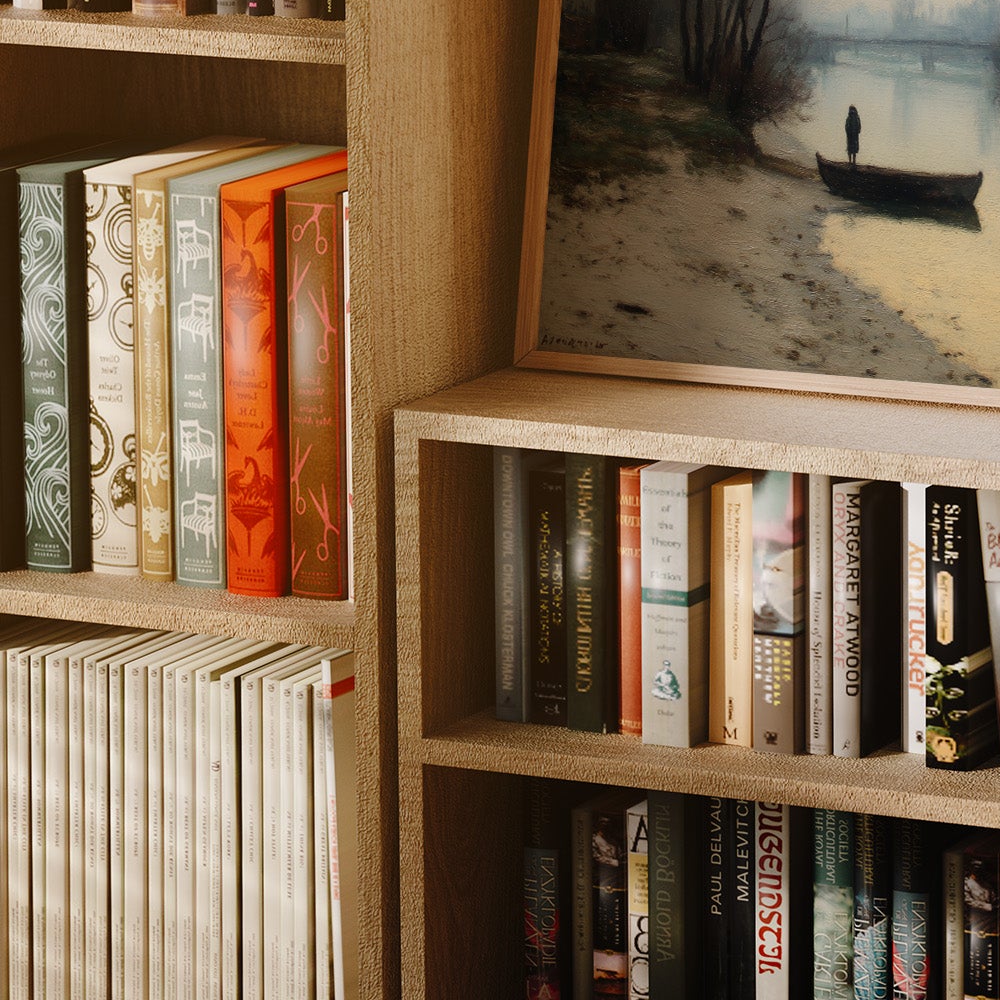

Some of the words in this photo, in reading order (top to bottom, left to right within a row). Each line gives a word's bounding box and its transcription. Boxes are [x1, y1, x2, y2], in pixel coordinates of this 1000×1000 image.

[501, 454, 514, 529] DOWNTOWN
[661, 504, 670, 513] of
[501, 531, 514, 558] OWL
[650, 538, 682, 550] Theory
[833, 492, 846, 545] ORYX
[661, 554, 671, 564] of
[834, 553, 846, 593] AND
[845, 492, 860, 606] MARGARET
[501, 564, 514, 606] CHUCK
[650, 571, 682, 583] Fiction
[501, 608, 514, 690] KLOSTERMAN
[833, 600, 846, 669] CRAKE
[845, 611, 860, 698] ATWOOD
[908, 604, 925, 696] rucker
[764, 638, 772, 704] MATTHEW
[773, 639, 781, 706] FREEFALL
[812, 640, 823, 690] Splendid
[812, 692, 823, 739] Isolation
[710, 797, 722, 866] DELVAU
[710, 872, 722, 916] PAUL
[758, 802, 782, 974] JUGENDSTIL
